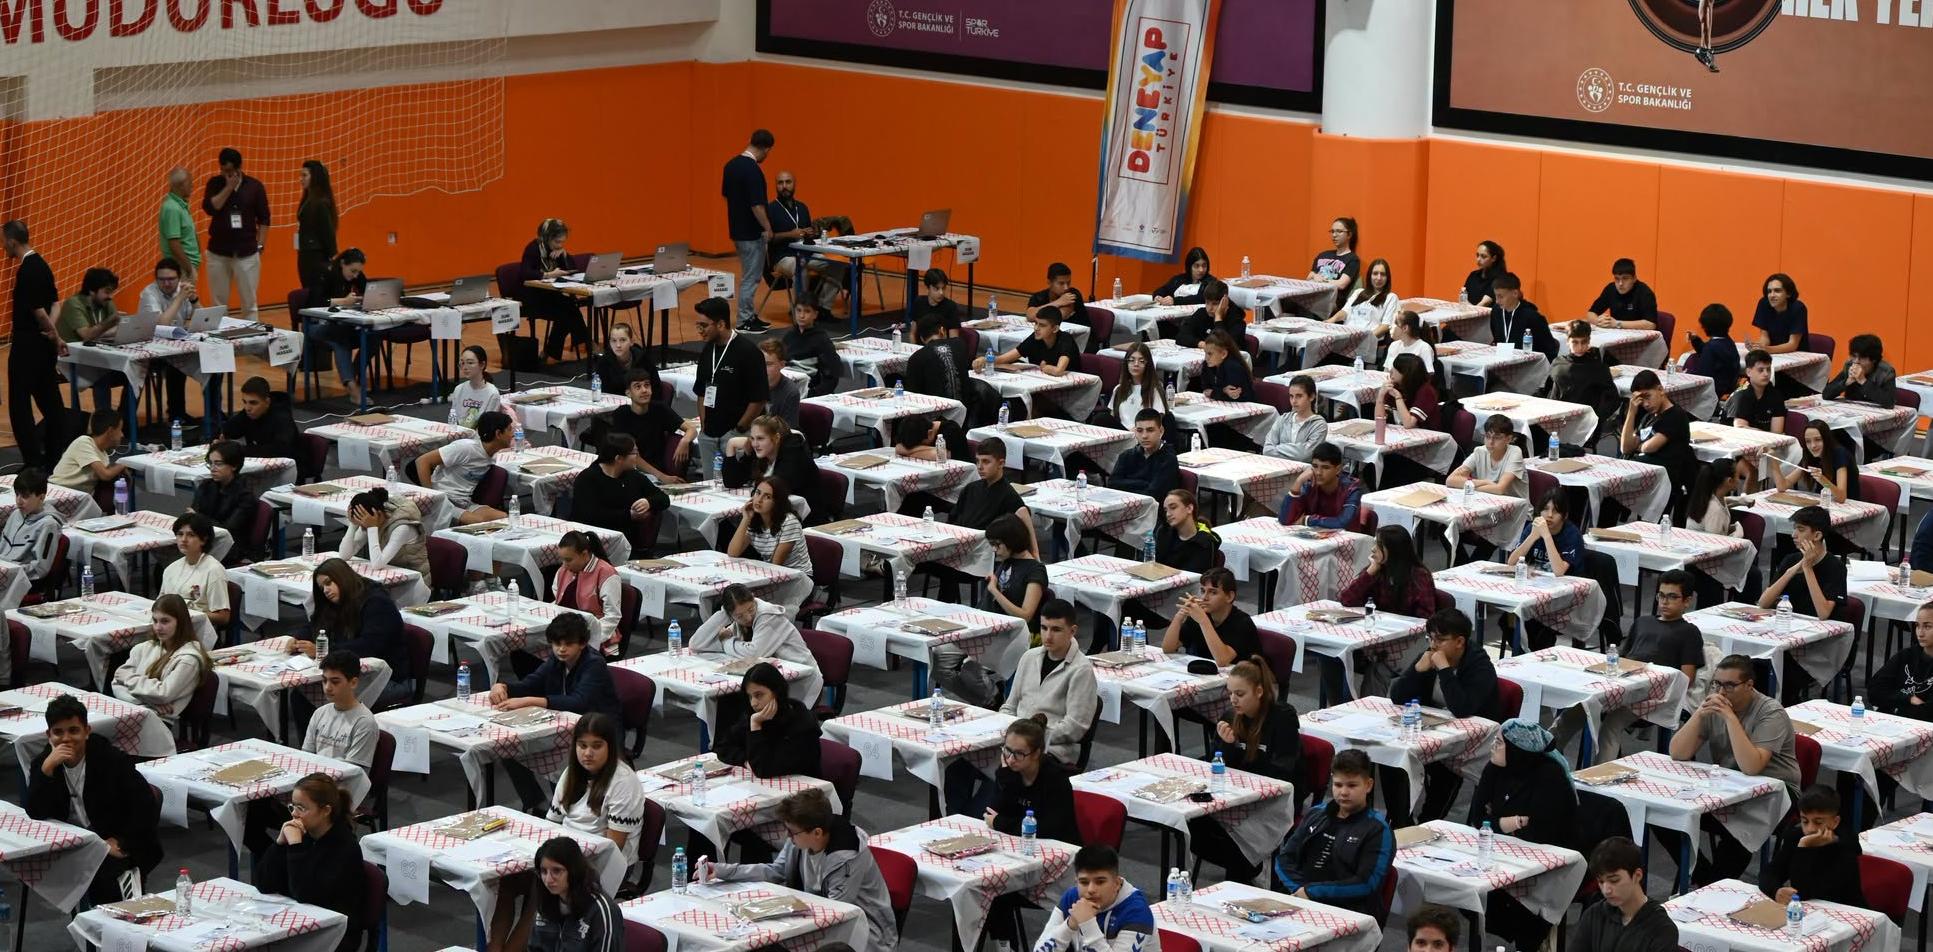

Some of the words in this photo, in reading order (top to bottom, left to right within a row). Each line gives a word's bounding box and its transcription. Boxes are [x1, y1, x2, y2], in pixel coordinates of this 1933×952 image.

[899, 21, 917, 30] SPOR
[944, 15, 954, 23] VE
[1618, 82, 1635, 93] T.C.
[1637, 84, 1678, 97] GENÇLİK
[1680, 88, 1692, 98] VE
[1127, 27, 1167, 173] DENEYAP
[1156, 52, 1179, 152] TÜRKİYE
[1618, 94, 1641, 105] SPOR
[1643, 97, 1692, 110] BAKANLIĞI
